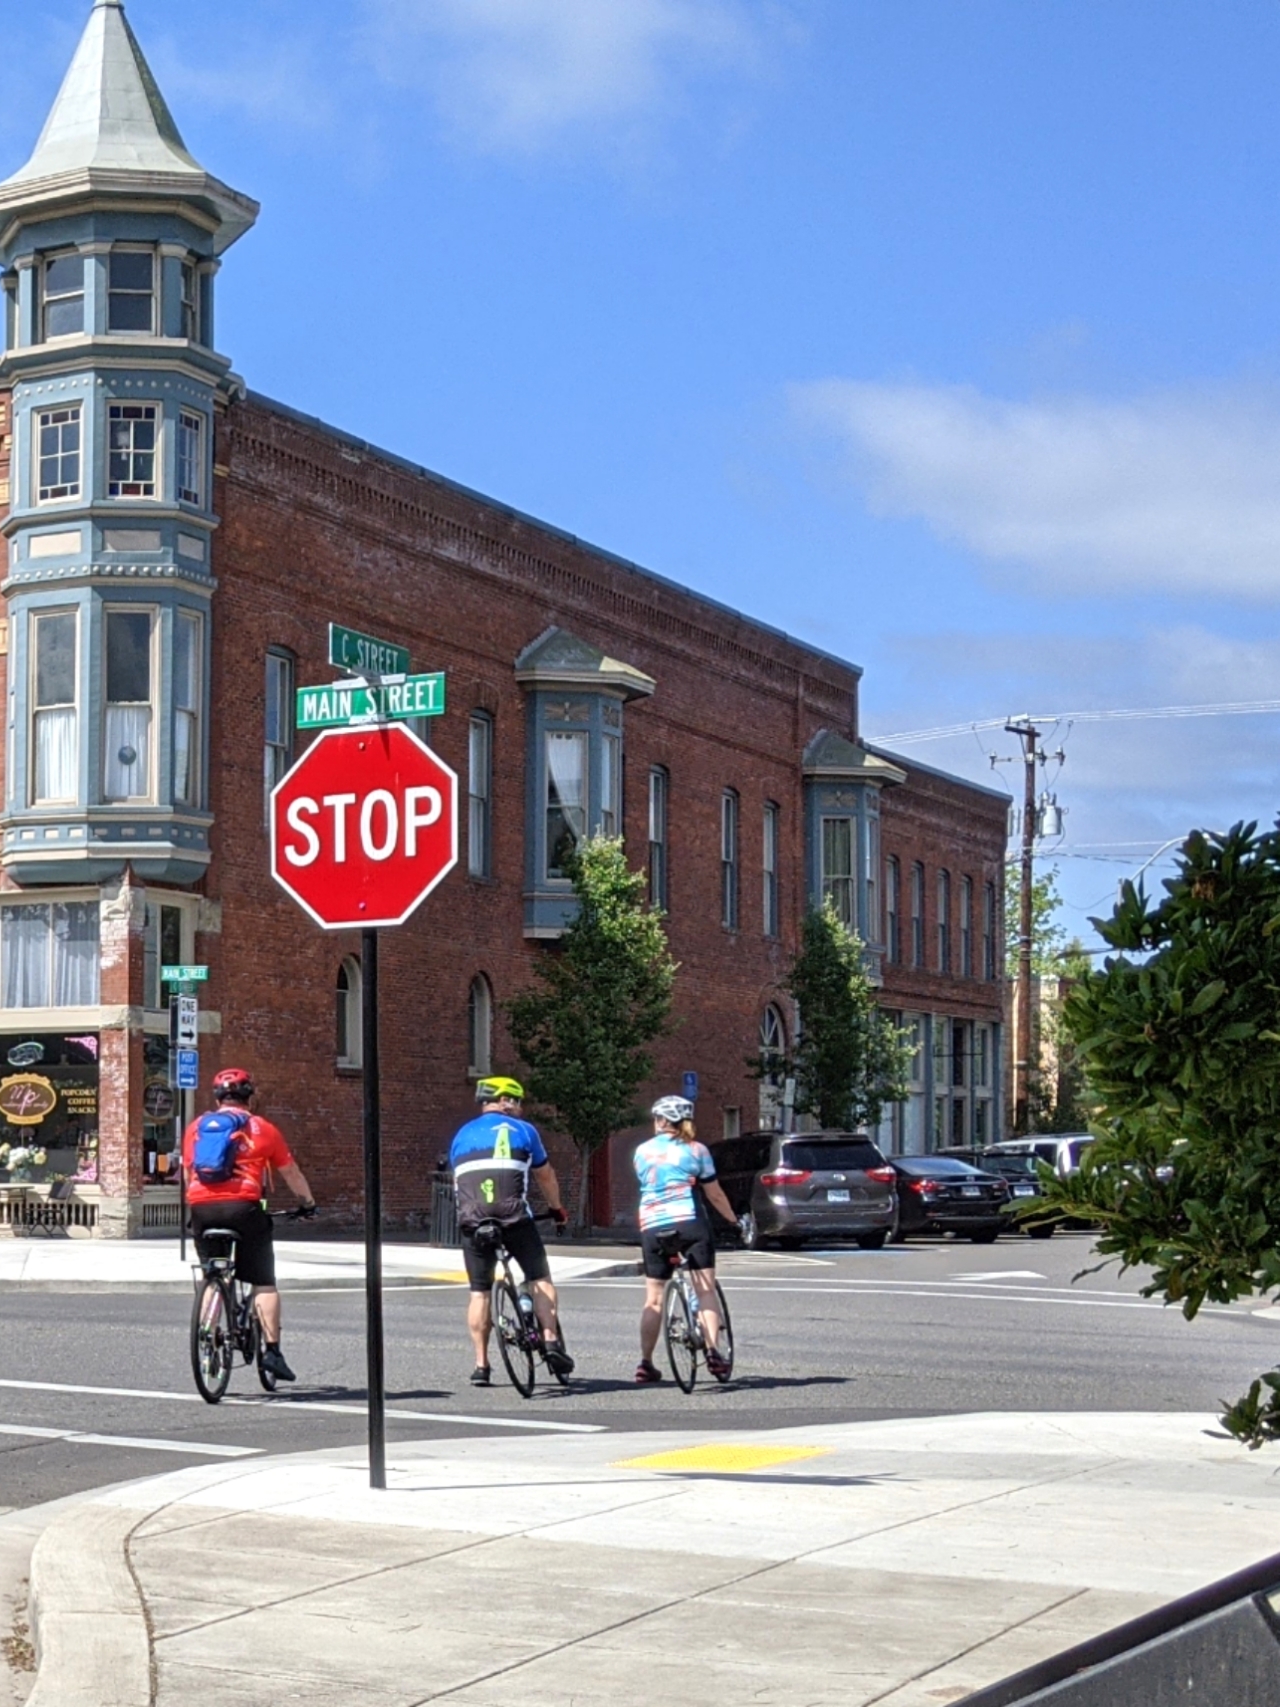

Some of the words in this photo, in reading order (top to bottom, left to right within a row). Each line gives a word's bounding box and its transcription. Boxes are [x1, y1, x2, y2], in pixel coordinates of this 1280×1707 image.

[341, 634, 350, 663] C
[357, 638, 400, 674] STREET
[303, 689, 352, 722] MAIN
[366, 679, 437, 715] STREET
[284, 785, 442, 867] STOP
[181, 1000, 195, 1013] ONE
[181, 1015, 195, 1026] WAY
[67, 1106, 97, 1114] SNACKS
